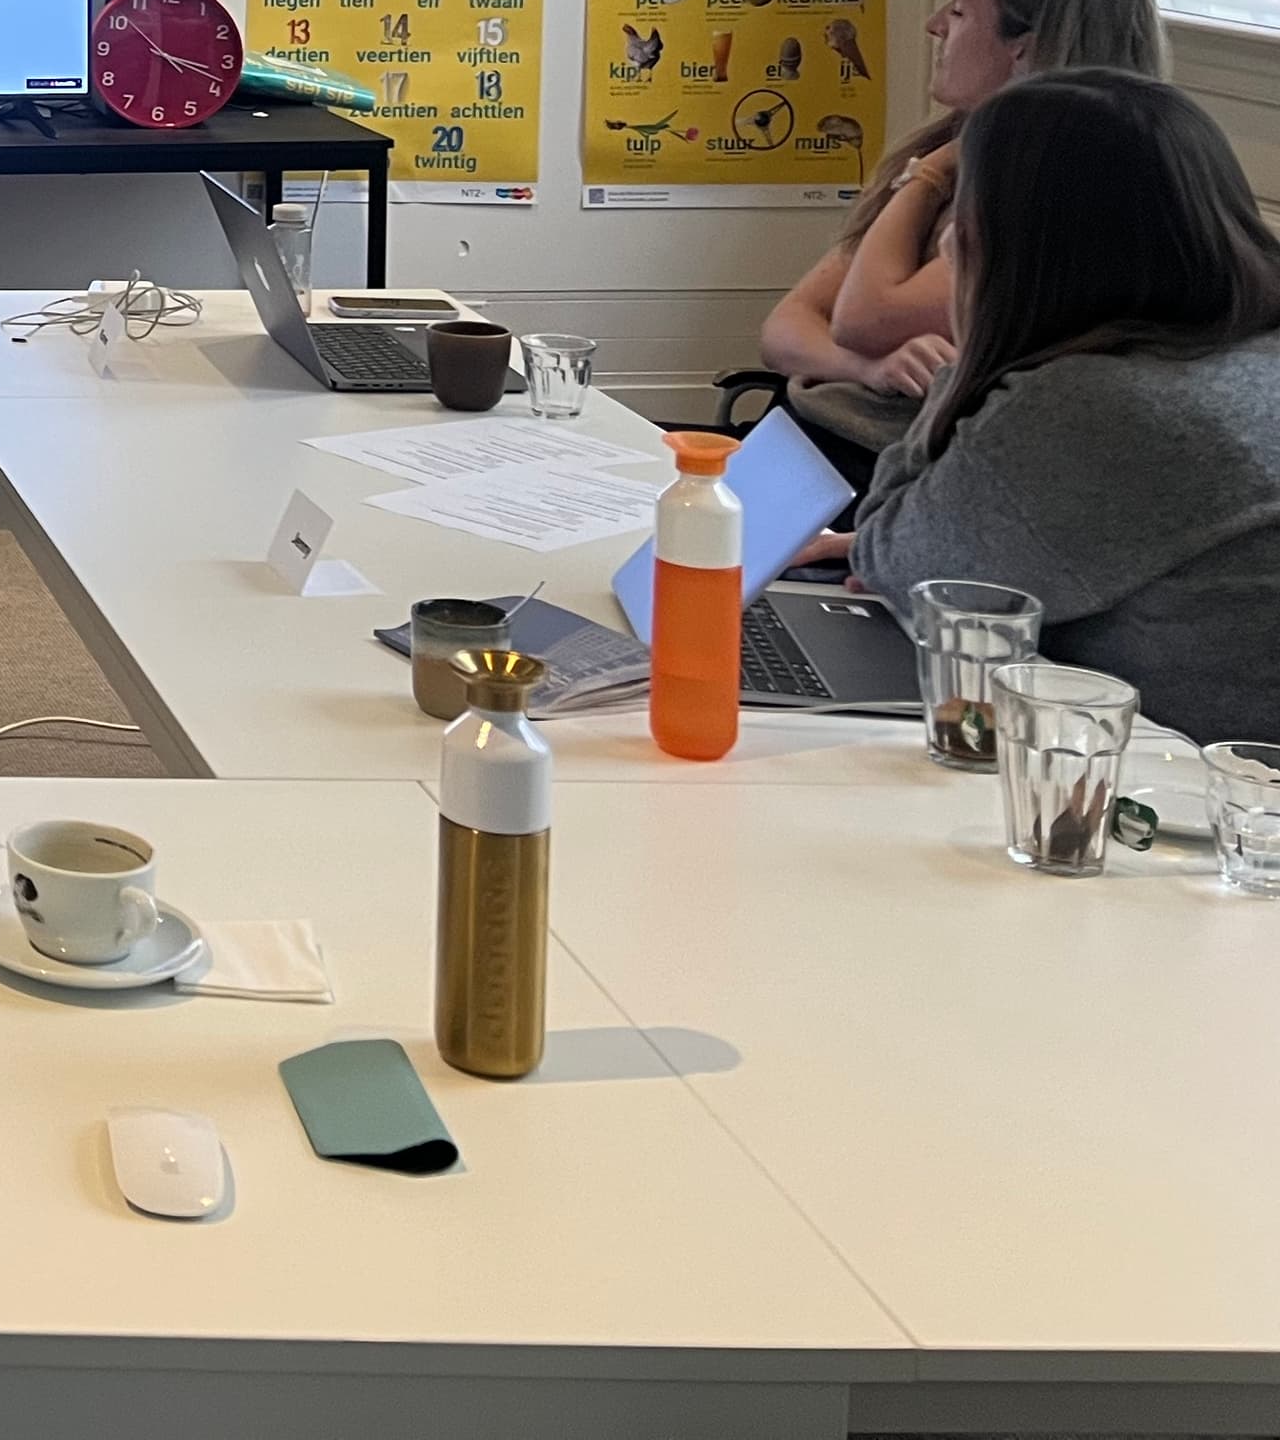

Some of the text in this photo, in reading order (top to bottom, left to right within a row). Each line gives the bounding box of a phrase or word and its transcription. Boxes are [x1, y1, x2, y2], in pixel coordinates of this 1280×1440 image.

[200, 2, 205, 16] 1
[109, 16, 128, 30] 10
[379, 14, 411, 46] 14
[216, 25, 229, 40] 2
[287, 19, 310, 45] 13
[476, 18, 503, 46] 15
[97, 42, 110, 56] 9
[356, 47, 431, 62] veertien
[221, 55, 234, 69] 3
[457, 48, 519, 67] vijftien
[610, 62, 637, 81] kip
[680, 62, 716, 78] bier
[766, 63, 782, 78] ei
[102, 71, 114, 86] 8
[475, 71, 502, 101] 18
[209, 82, 221, 97] 4
[380, 72, 408, 102] 17
[123, 95, 134, 109] 7
[184, 101, 197, 116] 5
[152, 107, 164, 121] 6
[450, 103, 524, 118] achttien
[432, 126, 464, 152] 20
[626, 137, 661, 155] tulp
[795, 135, 841, 150] muis
[414, 154, 477, 172] twintig
